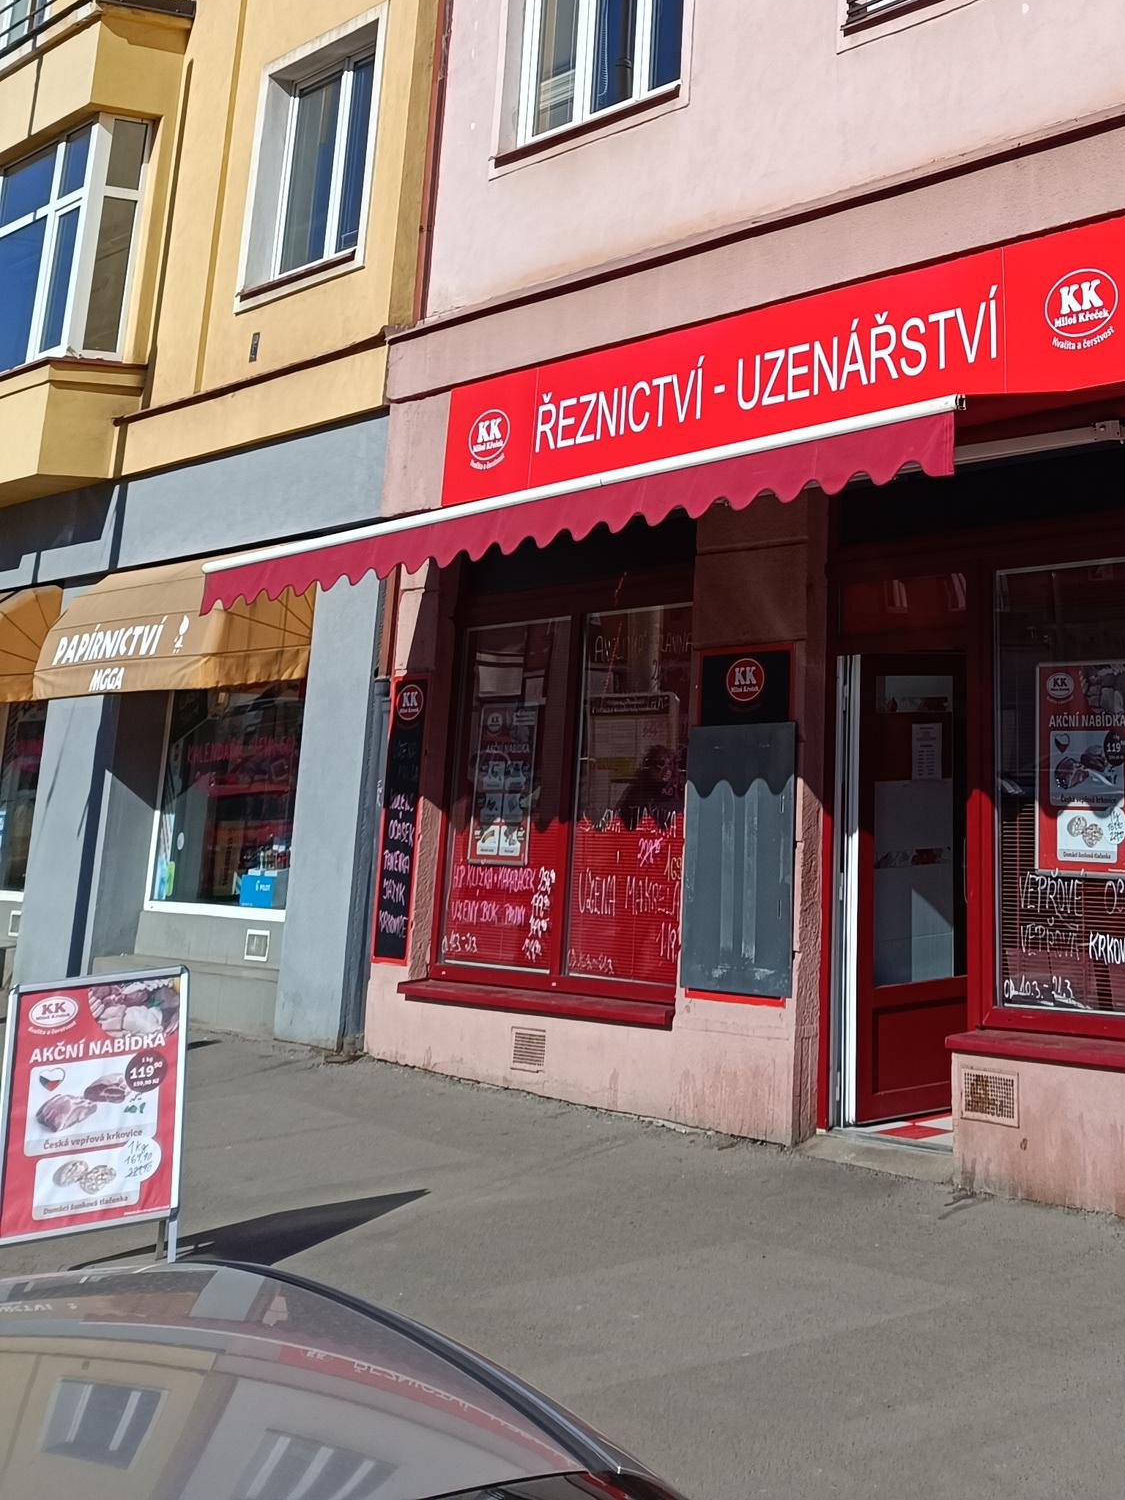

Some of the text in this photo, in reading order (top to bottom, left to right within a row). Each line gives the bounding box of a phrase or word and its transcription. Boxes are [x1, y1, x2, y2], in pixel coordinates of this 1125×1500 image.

[1059, 278, 1104, 315] KK
[1053, 313, 1078, 328] Miloš
[1051, 336, 1076, 350] Kvalita
[1082, 325, 1115, 349] čerstvost
[535, 355, 705, 453] ŘEZNICTVÍ
[736, 284, 1000, 411] UZENÁŘSTVÍ
[476, 416, 502, 444] KK
[51, 615, 168, 666] PAPÍRNICTVÍ
[734, 666, 757, 686] KK
[402, 691, 418, 707] KK
[1049, 712, 1080, 728] AKČNÍ
[42, 1001, 66, 1015] KK
[29, 1032, 167, 1064] AKČNÍ NABÍDKA
[43, 1128, 143, 1150] Česká vepřová krkovice
